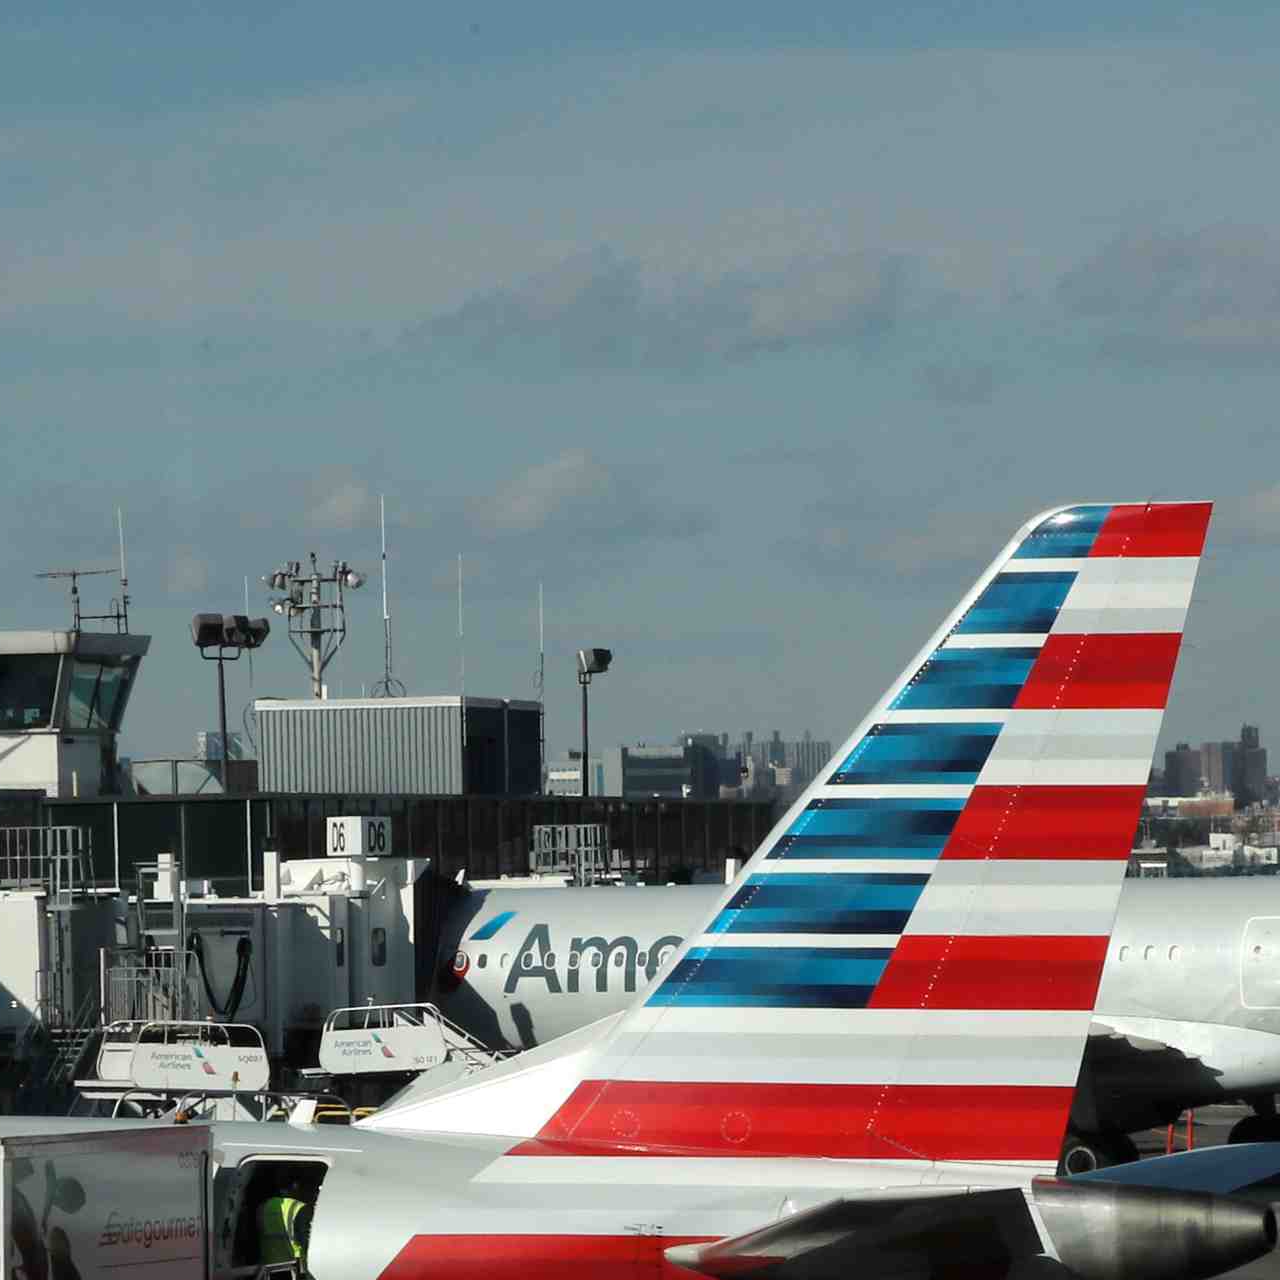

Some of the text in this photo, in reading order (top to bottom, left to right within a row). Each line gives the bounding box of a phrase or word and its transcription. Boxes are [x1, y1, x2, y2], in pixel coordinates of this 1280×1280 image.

[331, 821, 345, 852] D6
[367, 821, 385, 852] D6
[335, 1040, 372, 1048] American
[151, 1051, 193, 1060] American
[342, 1047, 373, 1056] Airlines
[159, 1060, 192, 1070] Airlines
